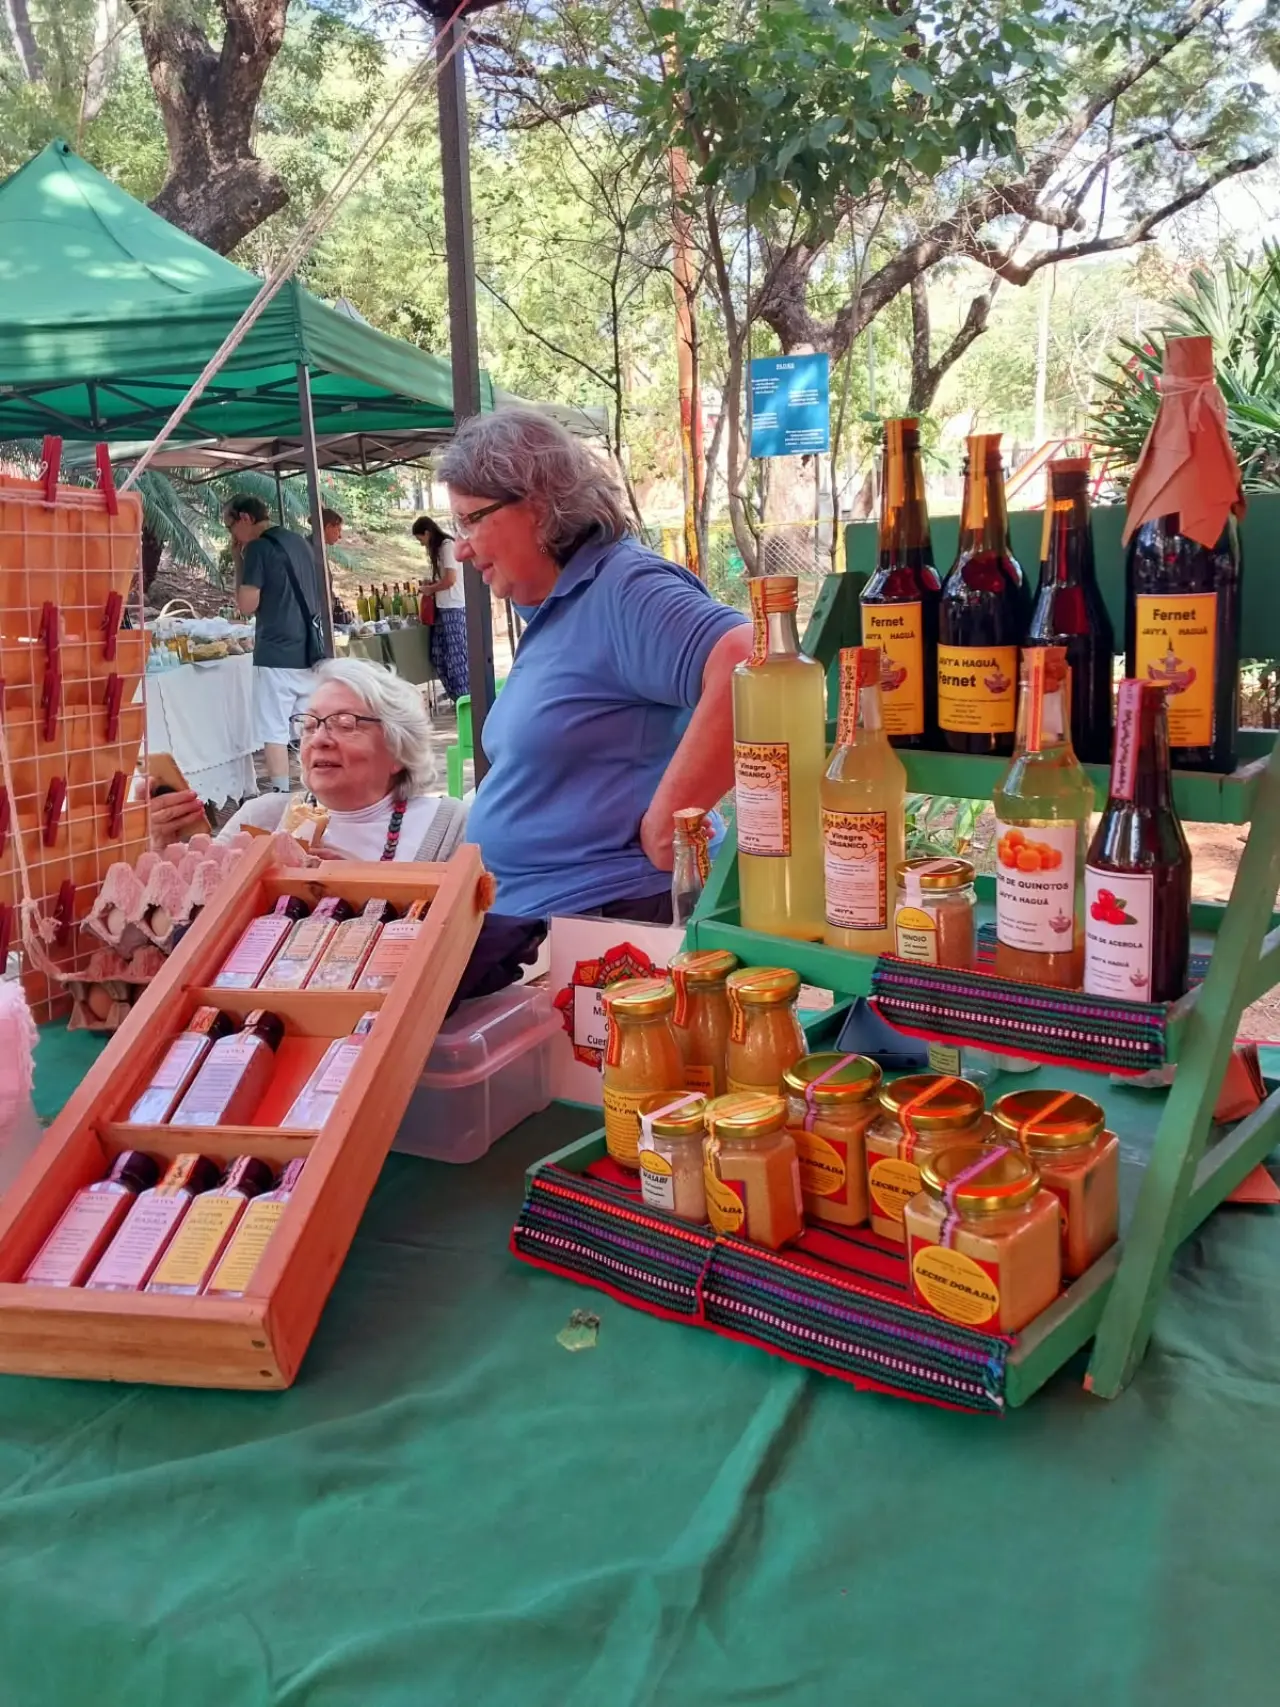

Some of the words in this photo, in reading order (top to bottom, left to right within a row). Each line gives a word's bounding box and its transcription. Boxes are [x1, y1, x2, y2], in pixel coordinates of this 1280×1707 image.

[1153, 608, 1197, 620] Fernet
[871, 616, 904, 627] Fernet
[740, 762, 767, 772] Vinagre
[831, 831, 864, 842] Vinagre
[1006, 877, 1016, 886] DE
[1018, 880, 1069, 891] QUINOTOS
[1108, 940, 1144, 949] ACEROLA
[808, 1158, 844, 1176] DORADA
[643, 1171, 669, 1184] WASABI
[871, 1179, 900, 1194] LECHE
[915, 1266, 950, 1286] LECHE
[949, 1280, 997, 1302] DORADA
